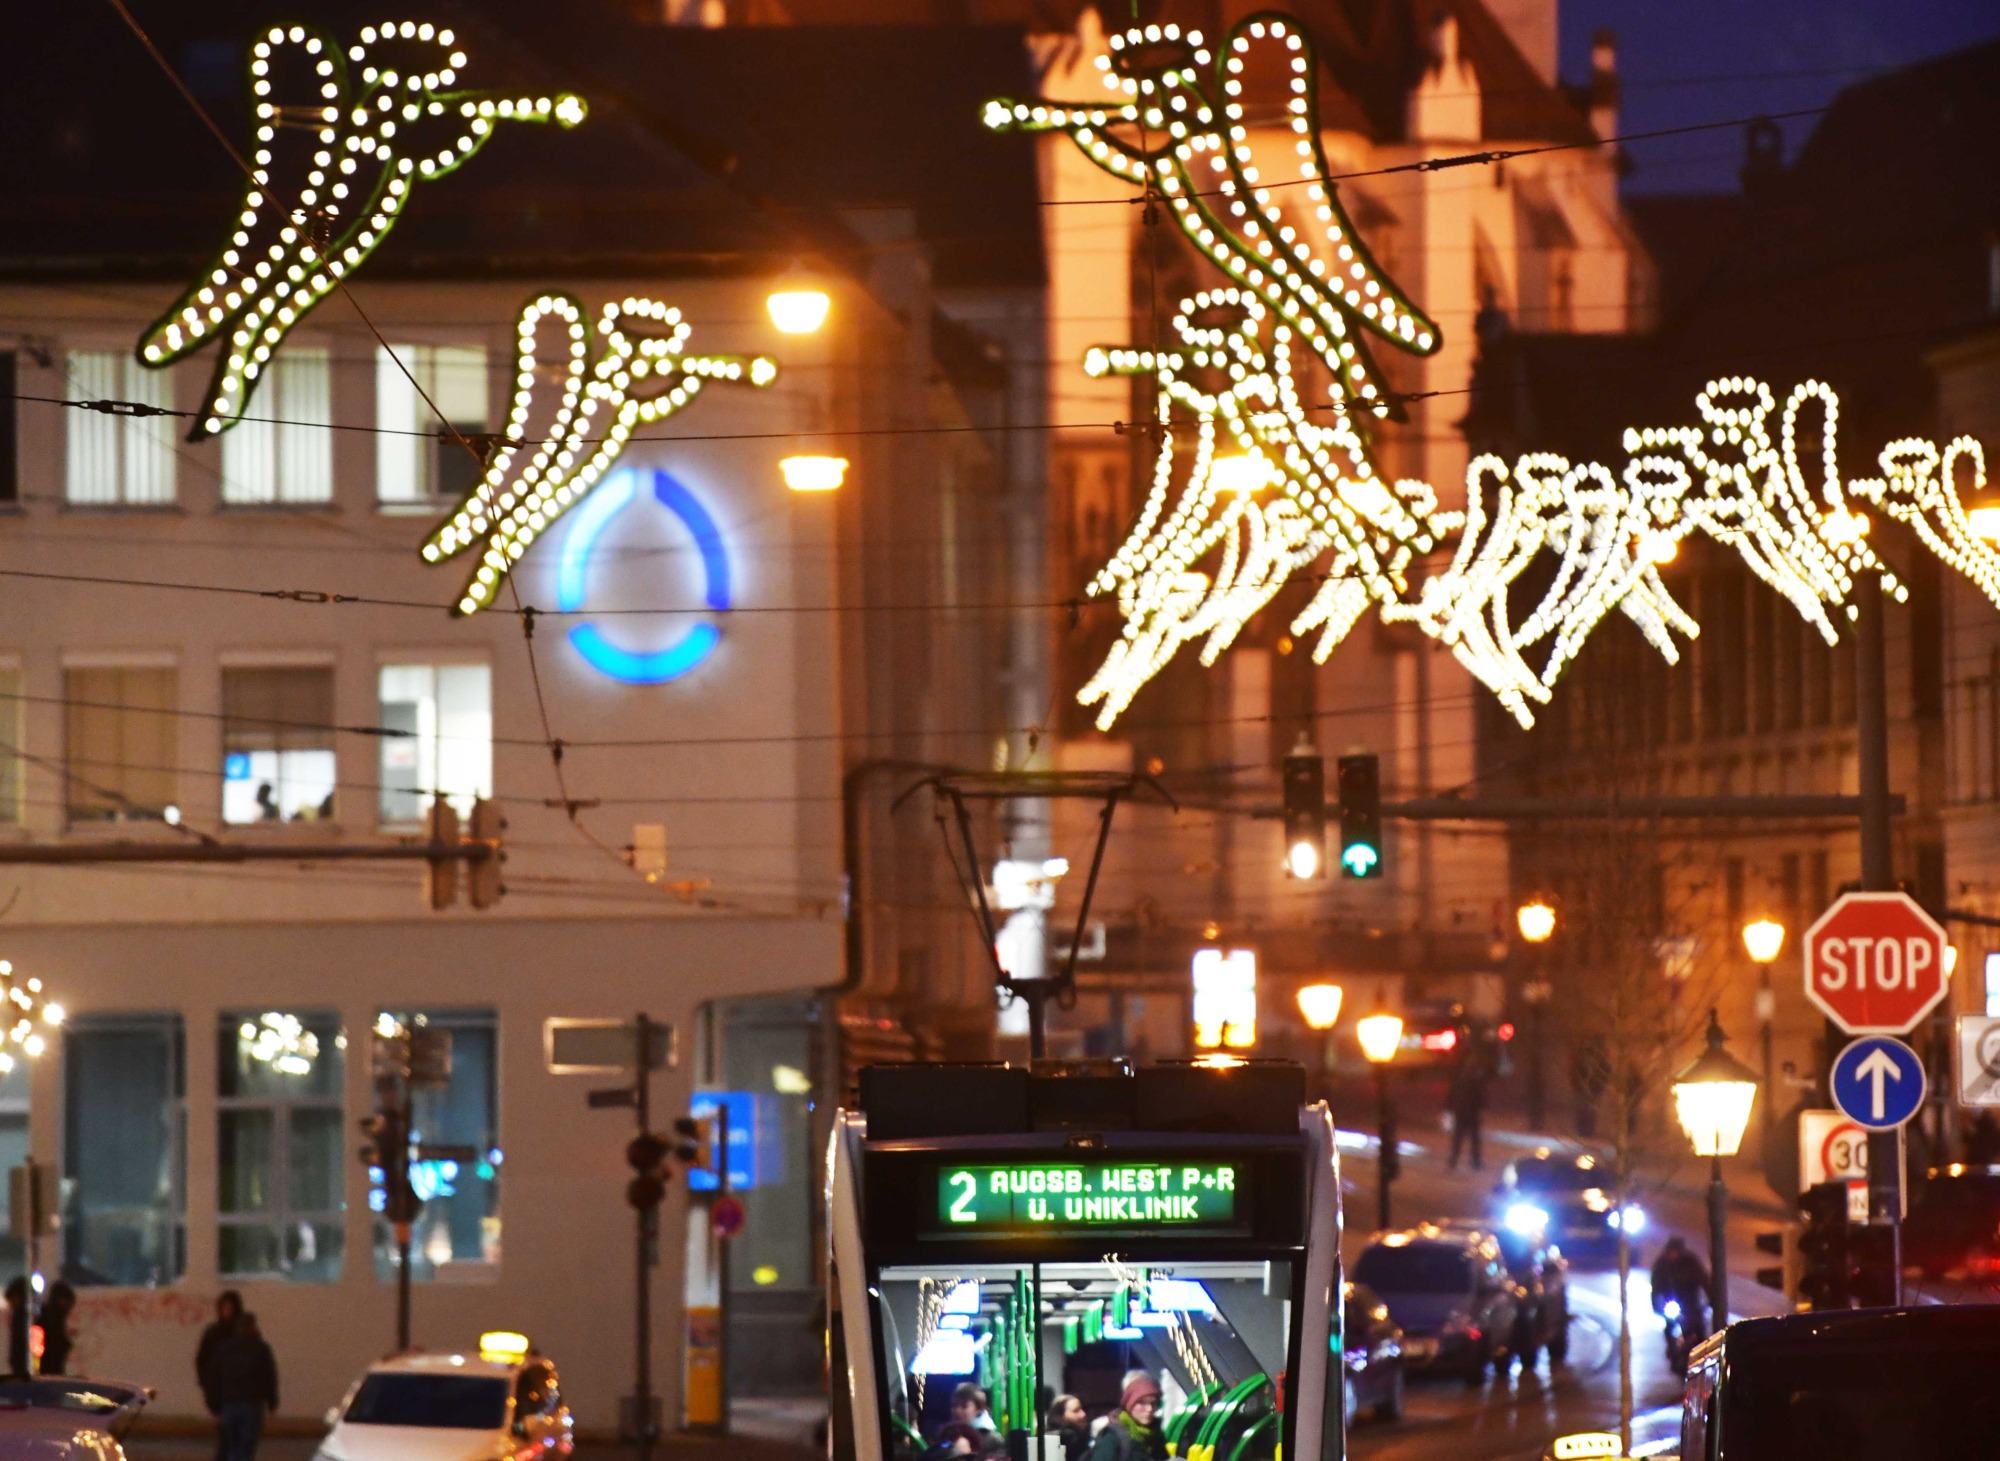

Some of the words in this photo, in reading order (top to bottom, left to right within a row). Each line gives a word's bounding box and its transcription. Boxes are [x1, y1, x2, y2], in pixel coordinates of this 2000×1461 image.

[1821, 937, 1932, 990] STOP
[950, 1171, 976, 1222] 2
[990, 1170, 1092, 1193] AUGSB.
[1102, 1168, 1171, 1192] WEST
[1183, 1167, 1234, 1191] P+R
[1065, 1196, 1198, 1220] UNIKLINIK
